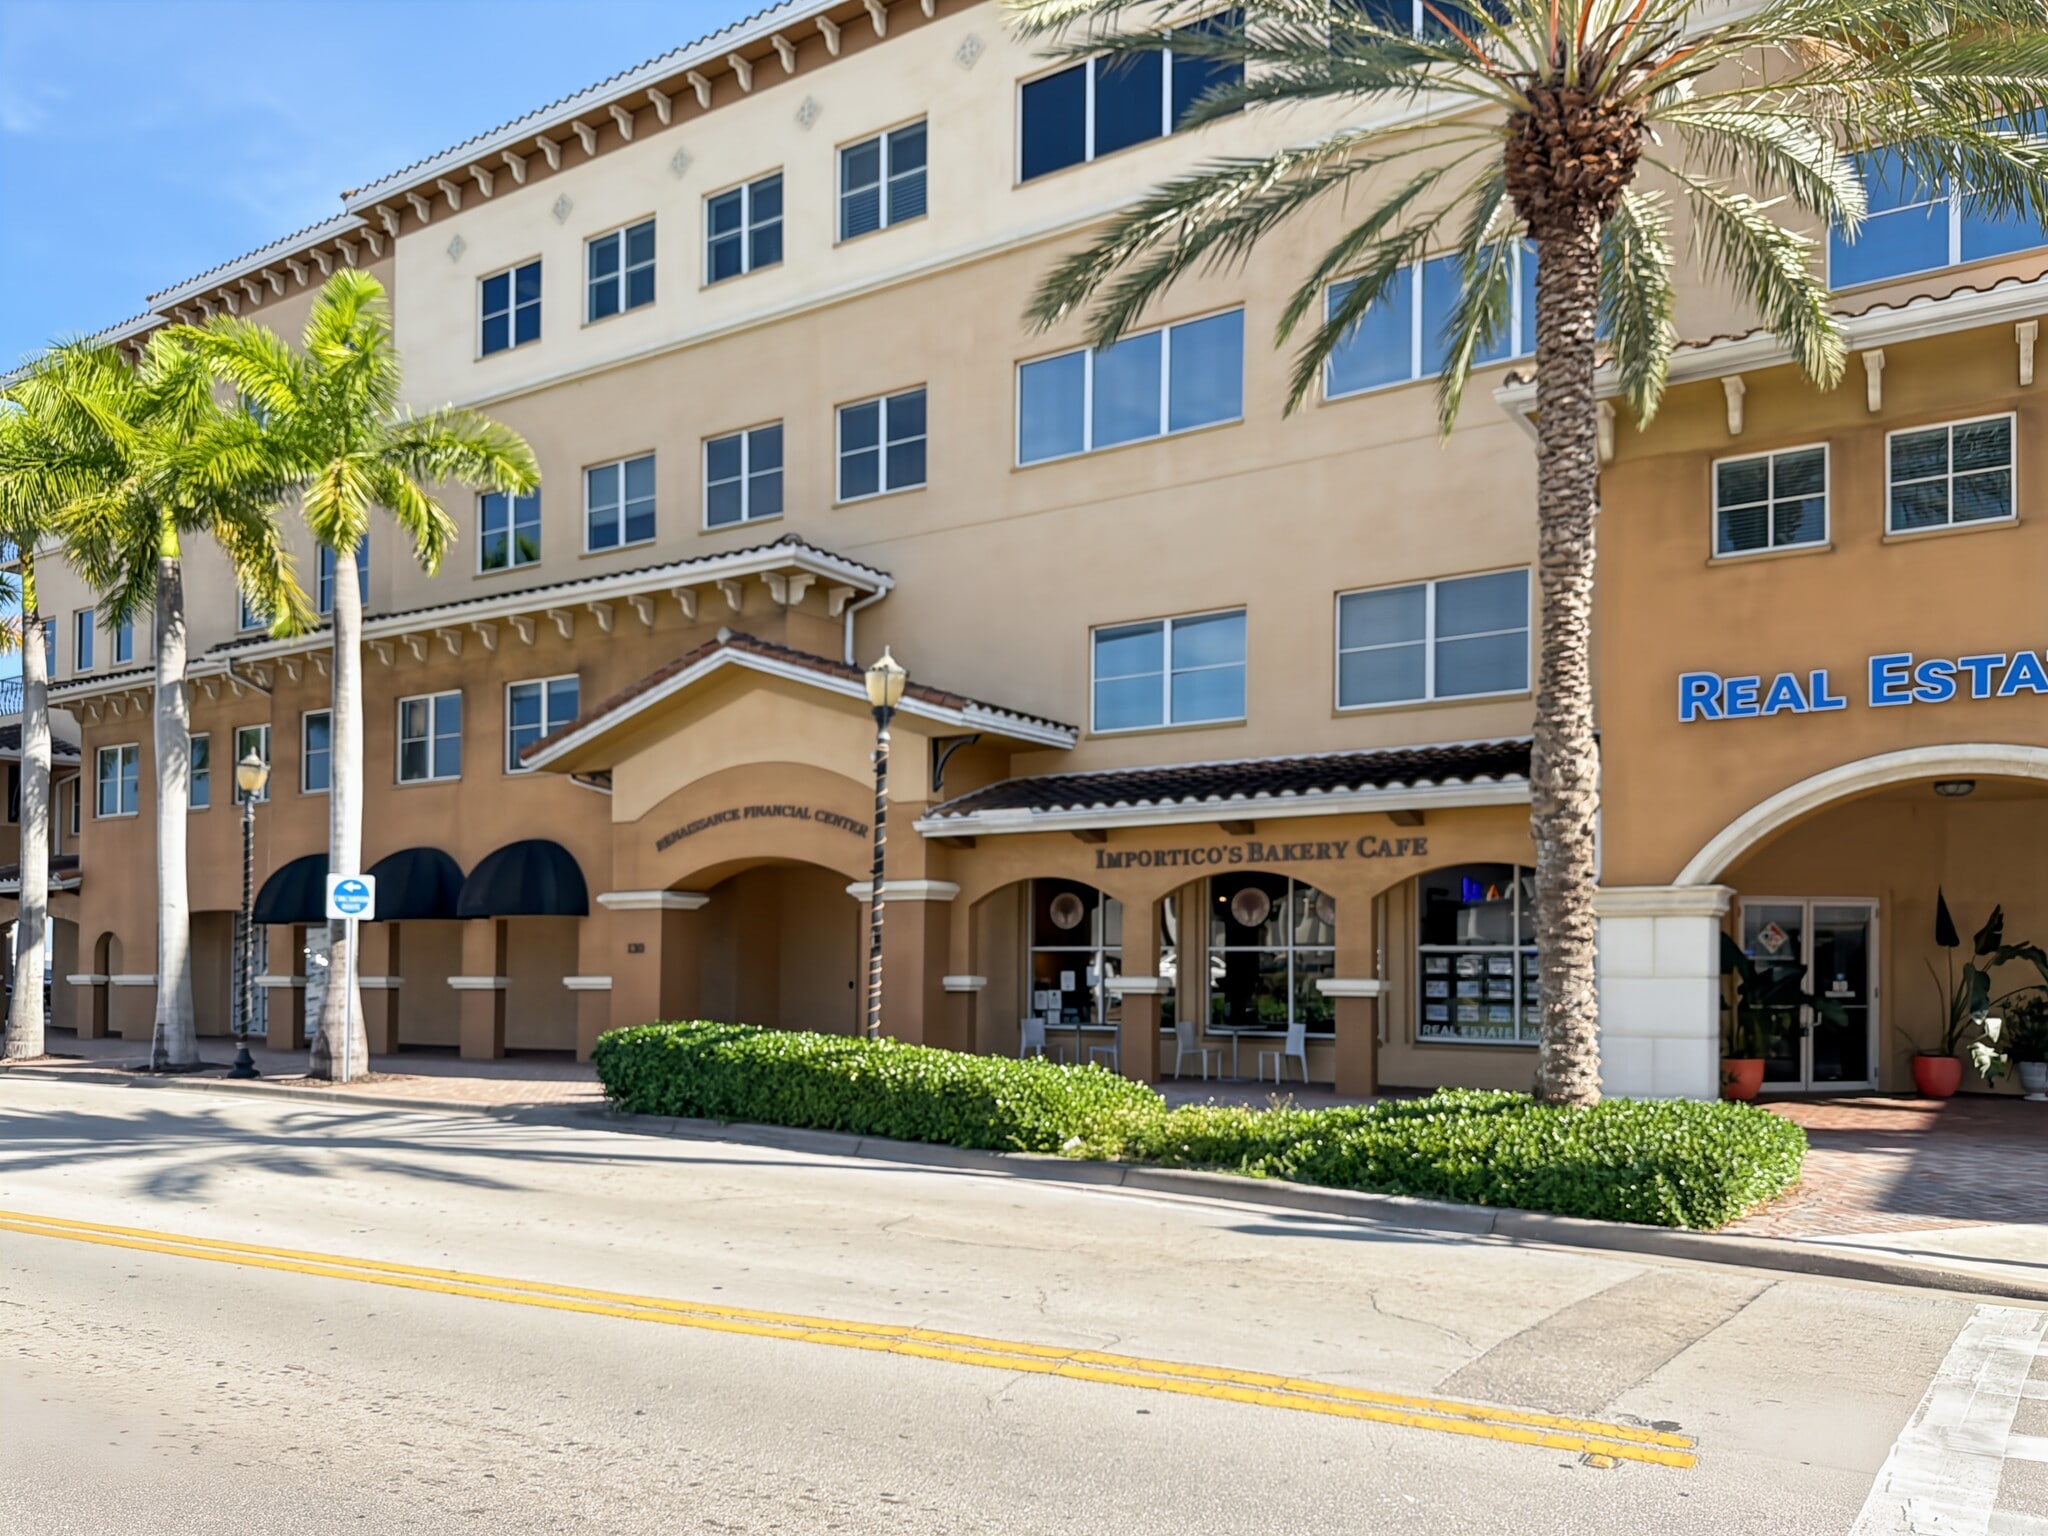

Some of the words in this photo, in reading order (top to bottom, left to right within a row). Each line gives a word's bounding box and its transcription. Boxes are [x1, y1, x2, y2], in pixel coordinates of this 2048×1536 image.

[1678, 669, 1847, 722] REAL
[1868, 649, 2048, 707] ESTA
[655, 808, 740, 852] RENAISSANCE
[743, 804, 812, 821] FINANCIAL
[814, 808, 870, 839] CENTER
[1096, 845, 1243, 869] IMPORTICO'S
[1246, 840, 1350, 864] BAKERY
[1356, 835, 1429, 859] CAFE
[1422, 1023, 1458, 1038] REAL
[1460, 1025, 1514, 1040] ESTATE
